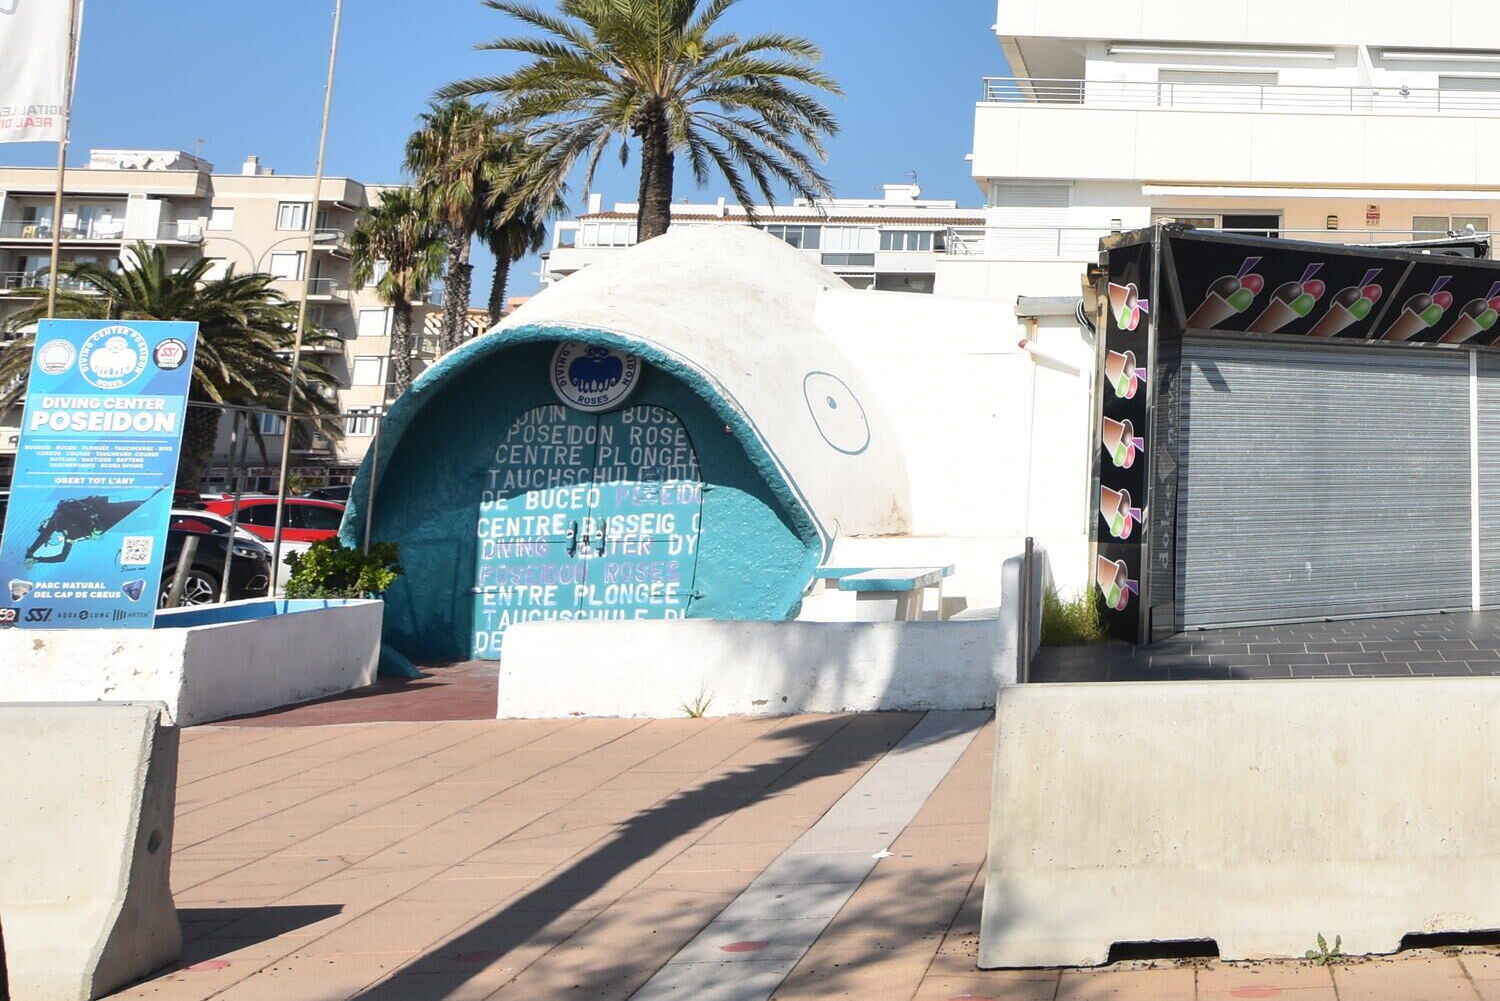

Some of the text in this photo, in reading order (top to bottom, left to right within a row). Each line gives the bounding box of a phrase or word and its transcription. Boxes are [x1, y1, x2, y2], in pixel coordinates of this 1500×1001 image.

[42, 397, 165, 410] DIVING CENTER
[577, 394, 609, 405] ROSES
[30, 410, 175, 432] POSEIDON
[507, 424, 613, 445] POSEIDON
[495, 444, 584, 465] CENTRE
[480, 490, 509, 511] DE
[526, 487, 600, 510] BUCEO
[478, 513, 567, 538] CENTRE
[479, 560, 680, 586] POSEIDON ROSES
[89, 591, 121, 599] CREUS
[574, 580, 680, 606] PLONGÉE
